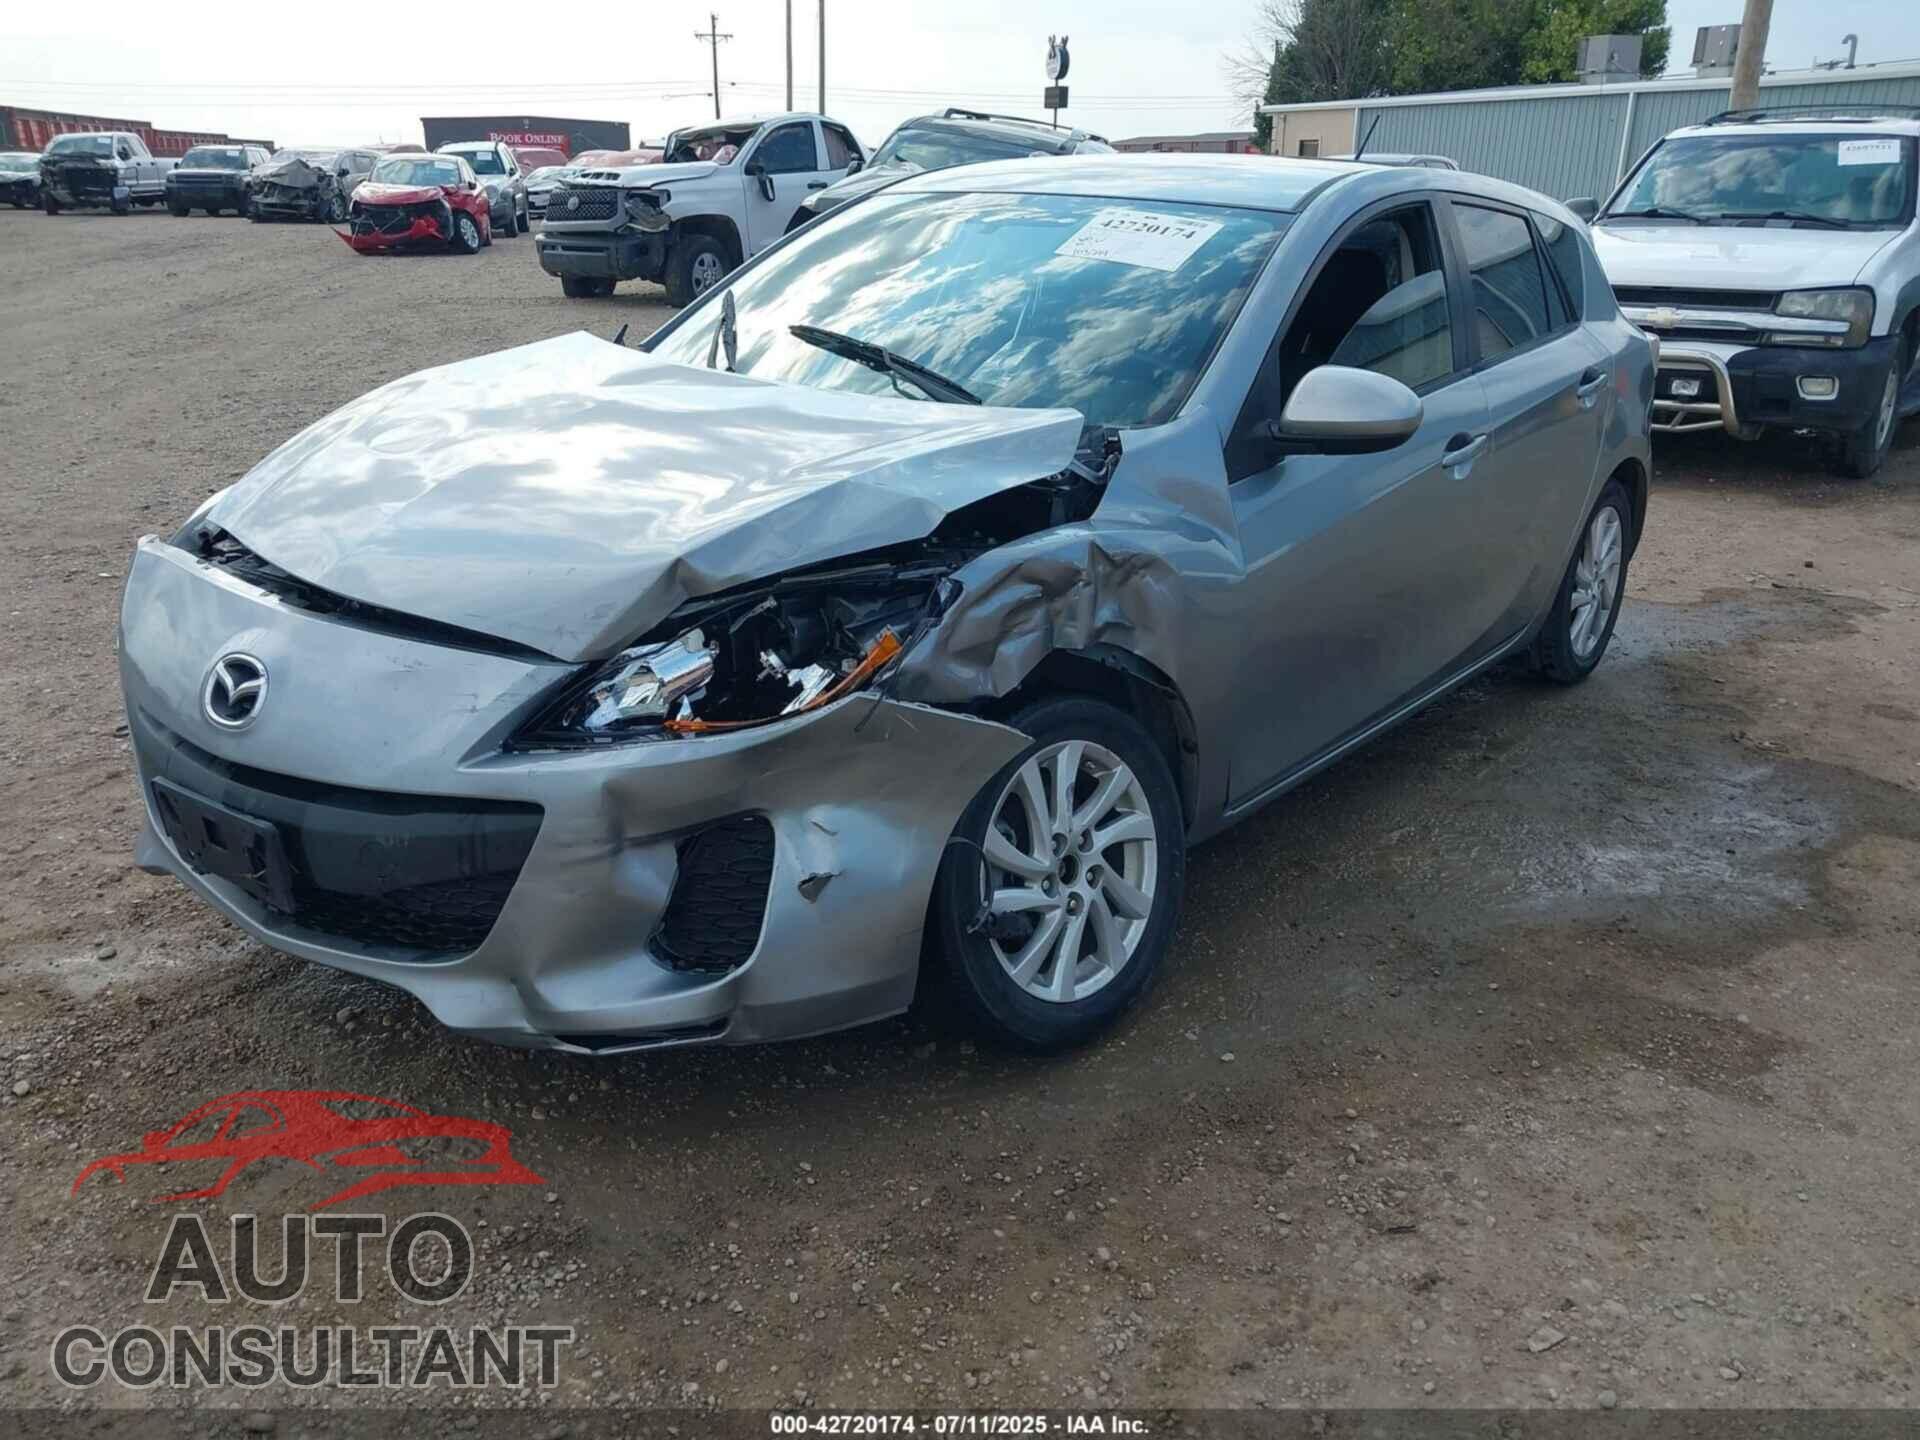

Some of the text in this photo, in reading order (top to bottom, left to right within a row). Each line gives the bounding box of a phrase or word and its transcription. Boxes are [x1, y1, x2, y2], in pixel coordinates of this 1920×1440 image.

[490, 132, 564, 145] BOOK ONLINE
[1101, 218, 1197, 240] 42720174
